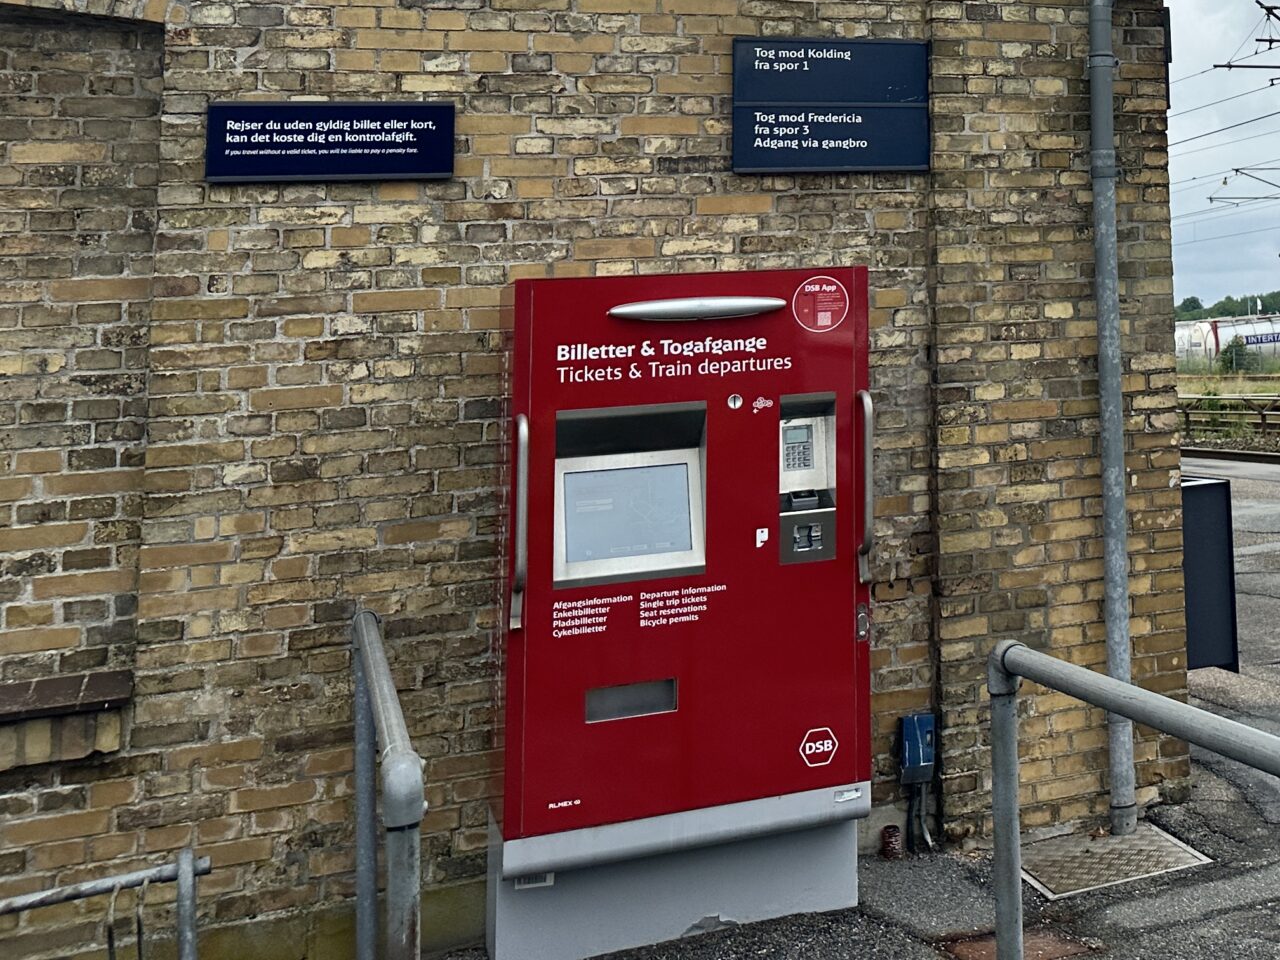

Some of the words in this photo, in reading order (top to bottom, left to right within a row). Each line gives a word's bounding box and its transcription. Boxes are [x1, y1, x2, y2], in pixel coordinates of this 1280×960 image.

[754, 47, 775, 59] Tog
[778, 48, 804, 58] mod
[808, 48, 851, 60] Kolding
[754, 60, 770, 70] fra
[773, 61, 799, 72] spor
[803, 61, 809, 70] 1
[754, 112, 775, 124] Tog
[778, 112, 804, 122] mod
[808, 113, 862, 123] Fredericia
[226, 120, 263, 132] Rejser
[265, 120, 281, 130] du
[283, 120, 313, 130] uden
[315, 120, 350, 131] gyldig
[353, 120, 381, 130] billet
[383, 120, 408, 130] eller
[410, 120, 436, 130] kort,
[754, 124, 770, 135] fra
[773, 126, 799, 136] spor
[803, 125, 810, 135] 3
[226, 132, 248, 143] kan
[250, 133, 270, 143] det
[273, 132, 305, 143] koste
[307, 132, 326, 144] dig
[328, 134, 342, 142] en
[345, 132, 417, 143] kontrolafgift.
[754, 137, 799, 149] Adgang
[801, 138, 819, 147] via
[821, 138, 868, 149] gangbro
[804, 284, 821, 292] DSB
[821, 284, 837, 292] App
[557, 343, 636, 361] Billetter
[640, 341, 655, 356] &
[660, 337, 768, 356] Togafgange
[557, 365, 623, 383] Tickets
[628, 363, 643, 379] &
[649, 360, 692, 378] Train
[698, 356, 793, 376] departures
[640, 590, 680, 600] Departure
[681, 584, 727, 595] information
[553, 595, 633, 610] Afgangsinformation
[640, 600, 664, 609] Single
[666, 598, 680, 607] trip
[682, 595, 708, 605] tickets
[553, 606, 611, 618] Enkeltbilletter
[640, 610, 657, 618] Seat
[659, 604, 708, 616] reservations
[553, 616, 607, 628] Pladsbilletter
[640, 617, 667, 627] Bicycle
[669, 614, 699, 625] permits
[552, 625, 607, 638] Cykelbilletter
[805, 739, 833, 755] DSB
